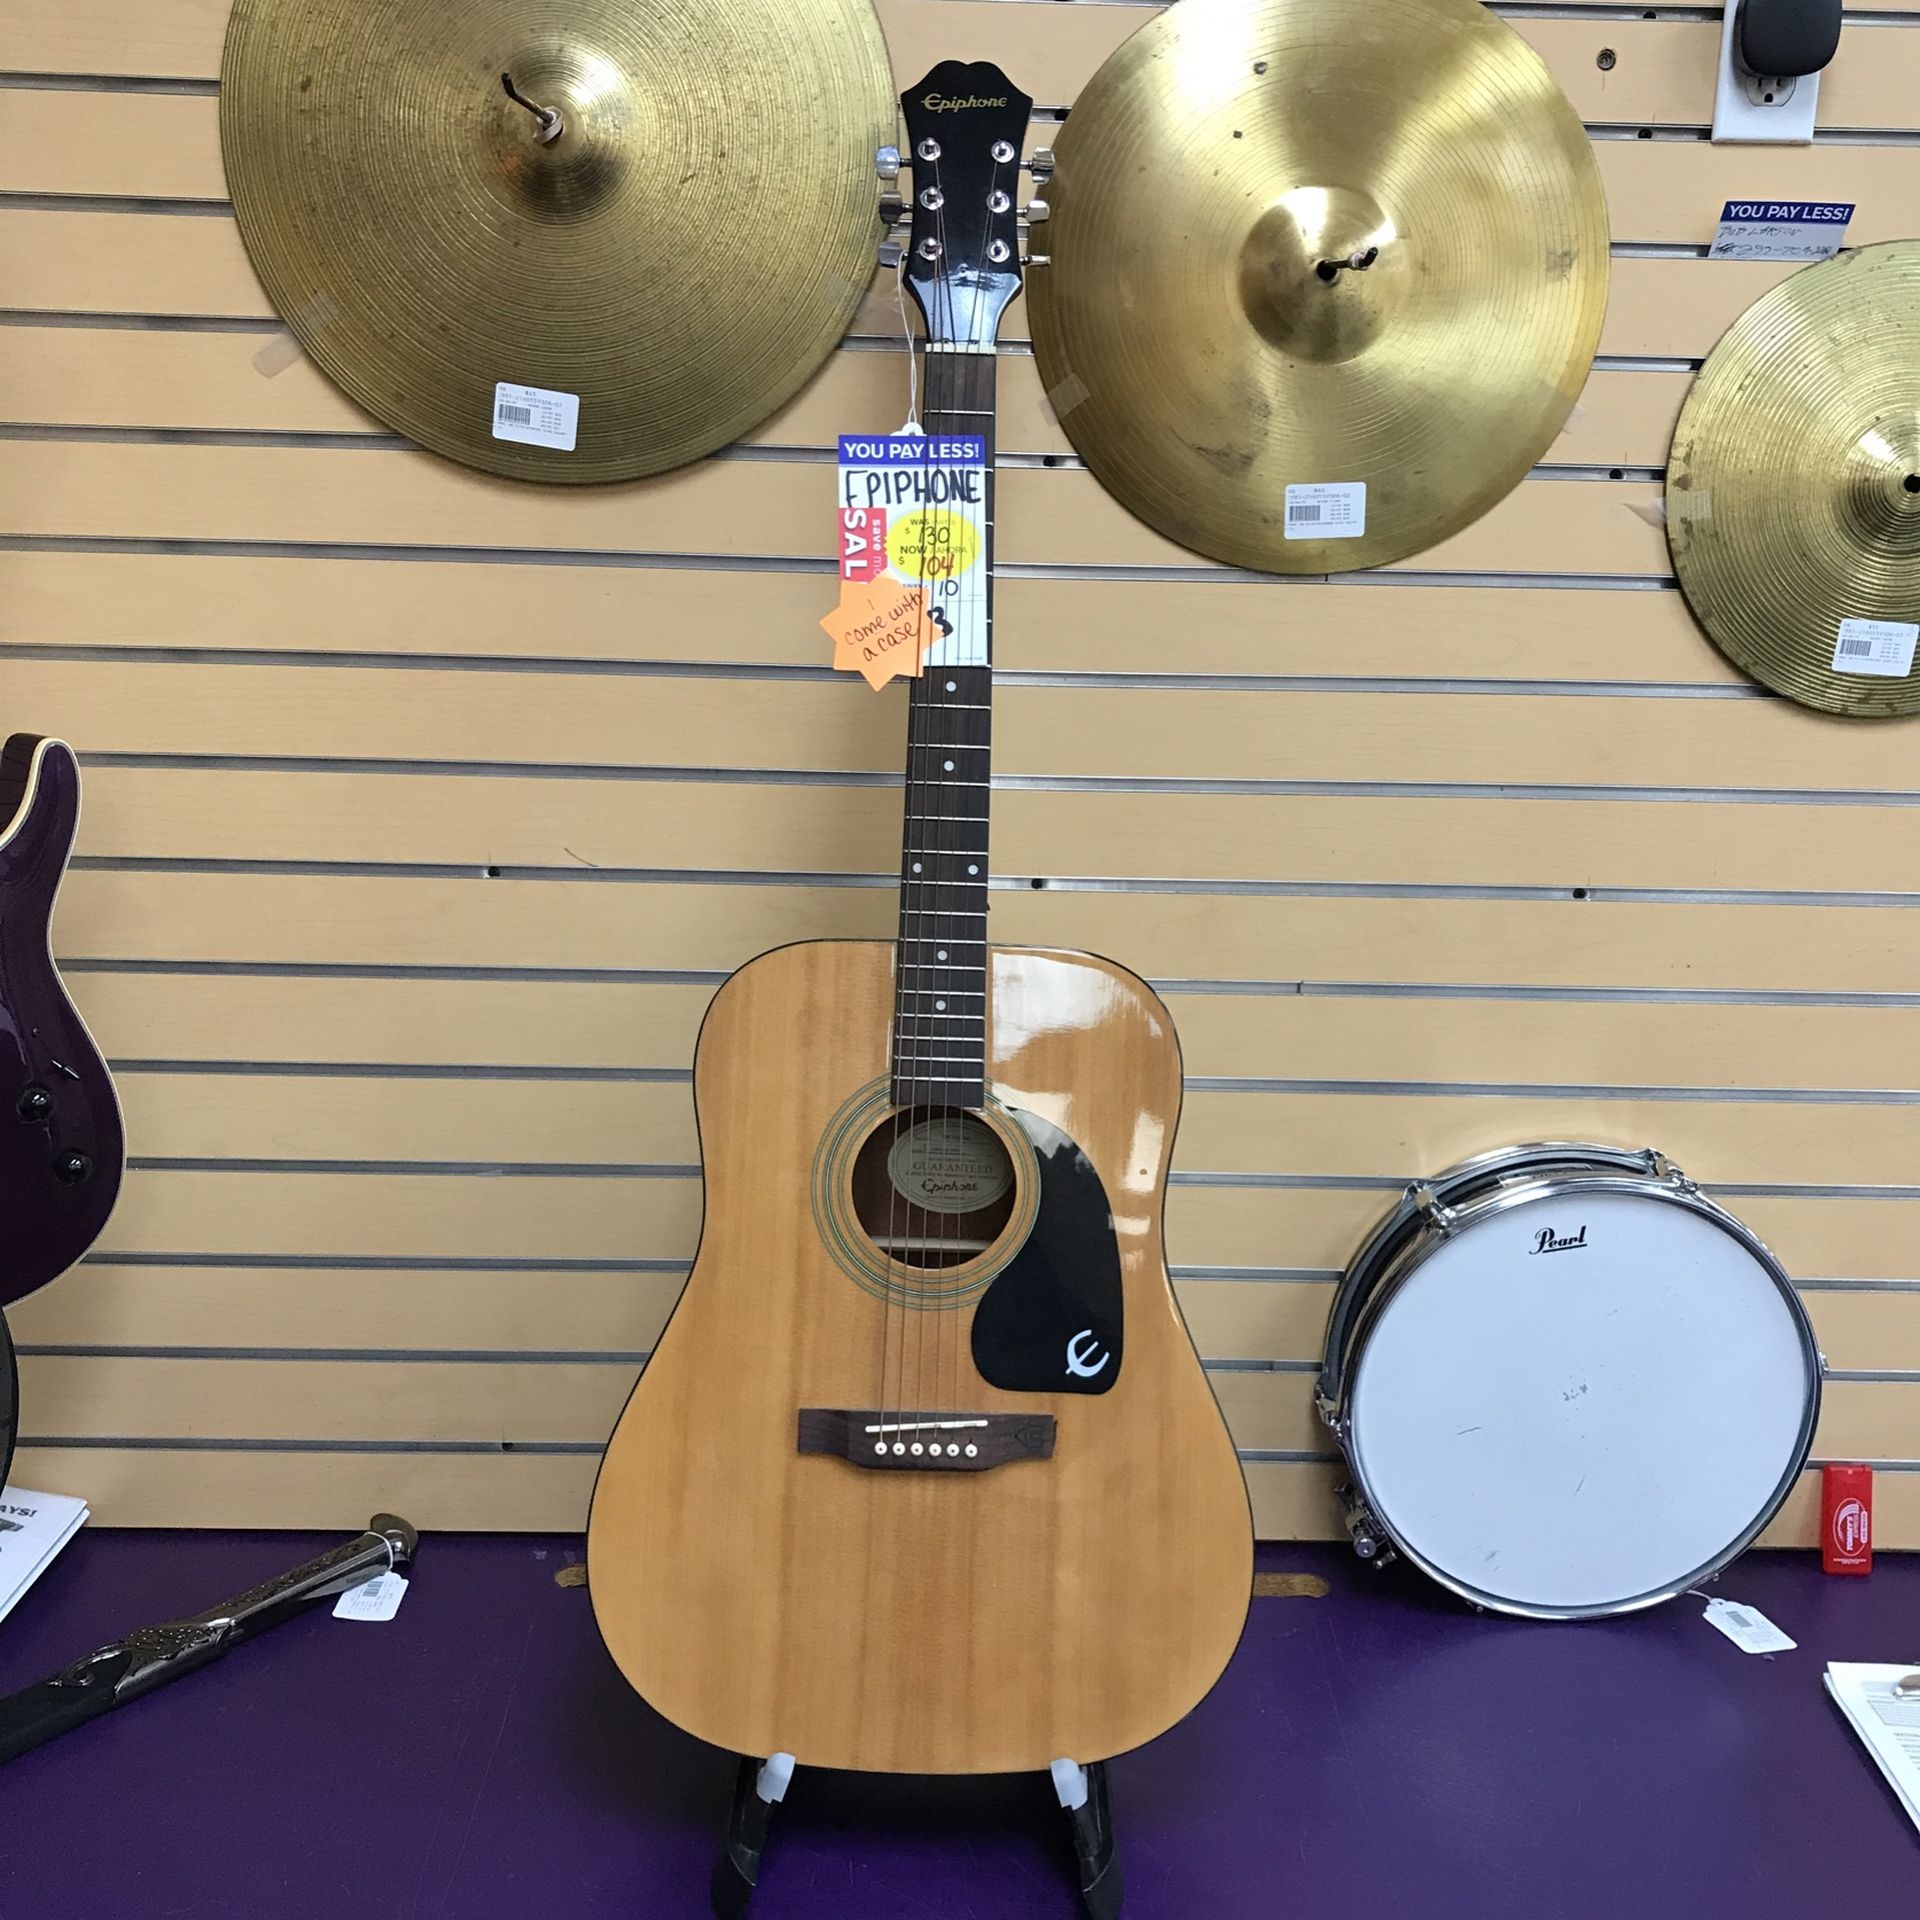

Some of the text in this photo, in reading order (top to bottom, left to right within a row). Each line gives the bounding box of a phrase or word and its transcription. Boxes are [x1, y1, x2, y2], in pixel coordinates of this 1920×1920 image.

[920, 93, 1009, 113] Epiphone
[1729, 204, 1850, 221] YOU PAY LESS!
[843, 443, 980, 460] YOU PAY LESS!
[845, 469, 982, 508] EPIPHONE
[910, 518, 930, 526] WAS
[872, 518, 882, 552] save
[918, 525, 951, 546] 130
[843, 509, 868, 584] SAL
[900, 545, 928, 555] NOW
[919, 552, 955, 577] 104
[938, 579, 959, 597] 10
[844, 592, 924, 646] come with
[862, 621, 919, 662] a case
[920, 1178, 979, 1195] Epiphone
[1528, 1224, 1588, 1256] Pearl
